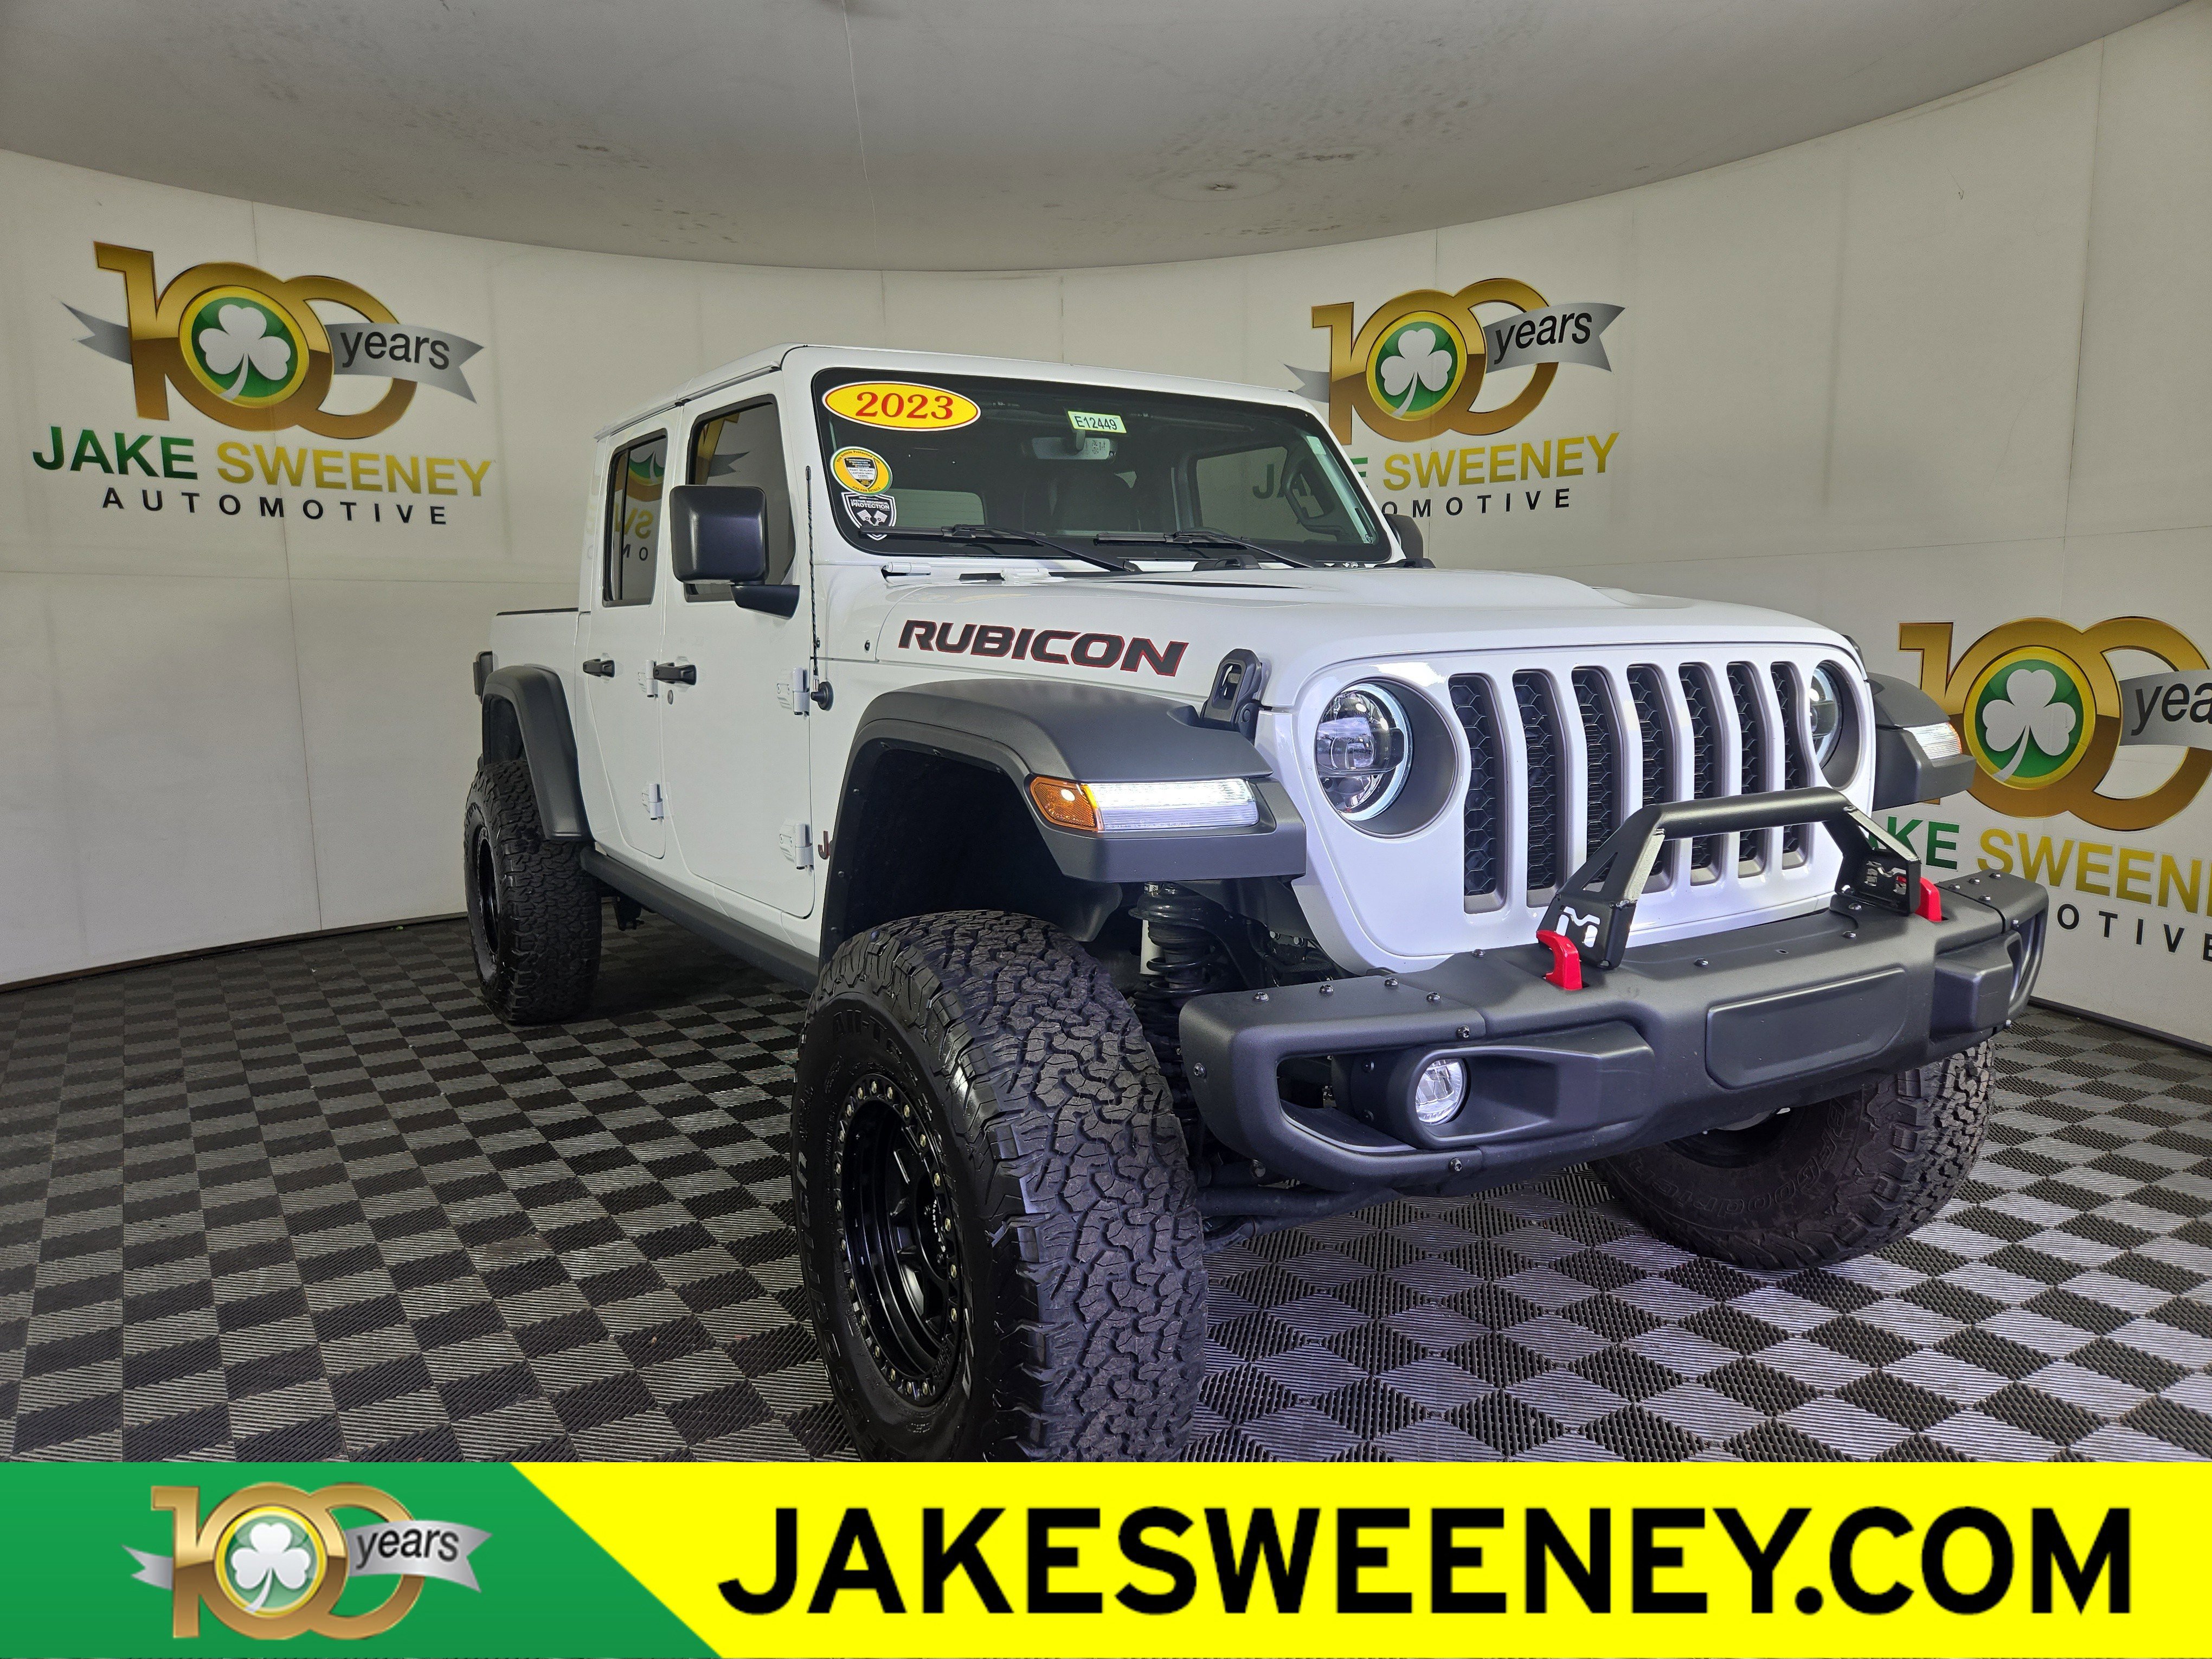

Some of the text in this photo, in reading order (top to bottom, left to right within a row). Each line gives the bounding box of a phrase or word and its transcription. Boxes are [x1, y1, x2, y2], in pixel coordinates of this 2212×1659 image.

[340, 331, 451, 371] years
[1494, 310, 1593, 365] years
[855, 391, 954, 421] 2023
[1075, 416, 1117, 430] E12449
[33, 426, 493, 497] JAKE SWEENEY
[1383, 432, 1620, 491] SWEENEY
[102, 487, 447, 525] AUTOMOTIVE
[1381, 488, 1570, 518] OMOTIVE
[898, 619, 1189, 677] RUBICON
[2130, 680, 2212, 736] yea
[1868, 816, 2212, 917] KE SWEEN
[2057, 903, 2212, 961] OTIVE
